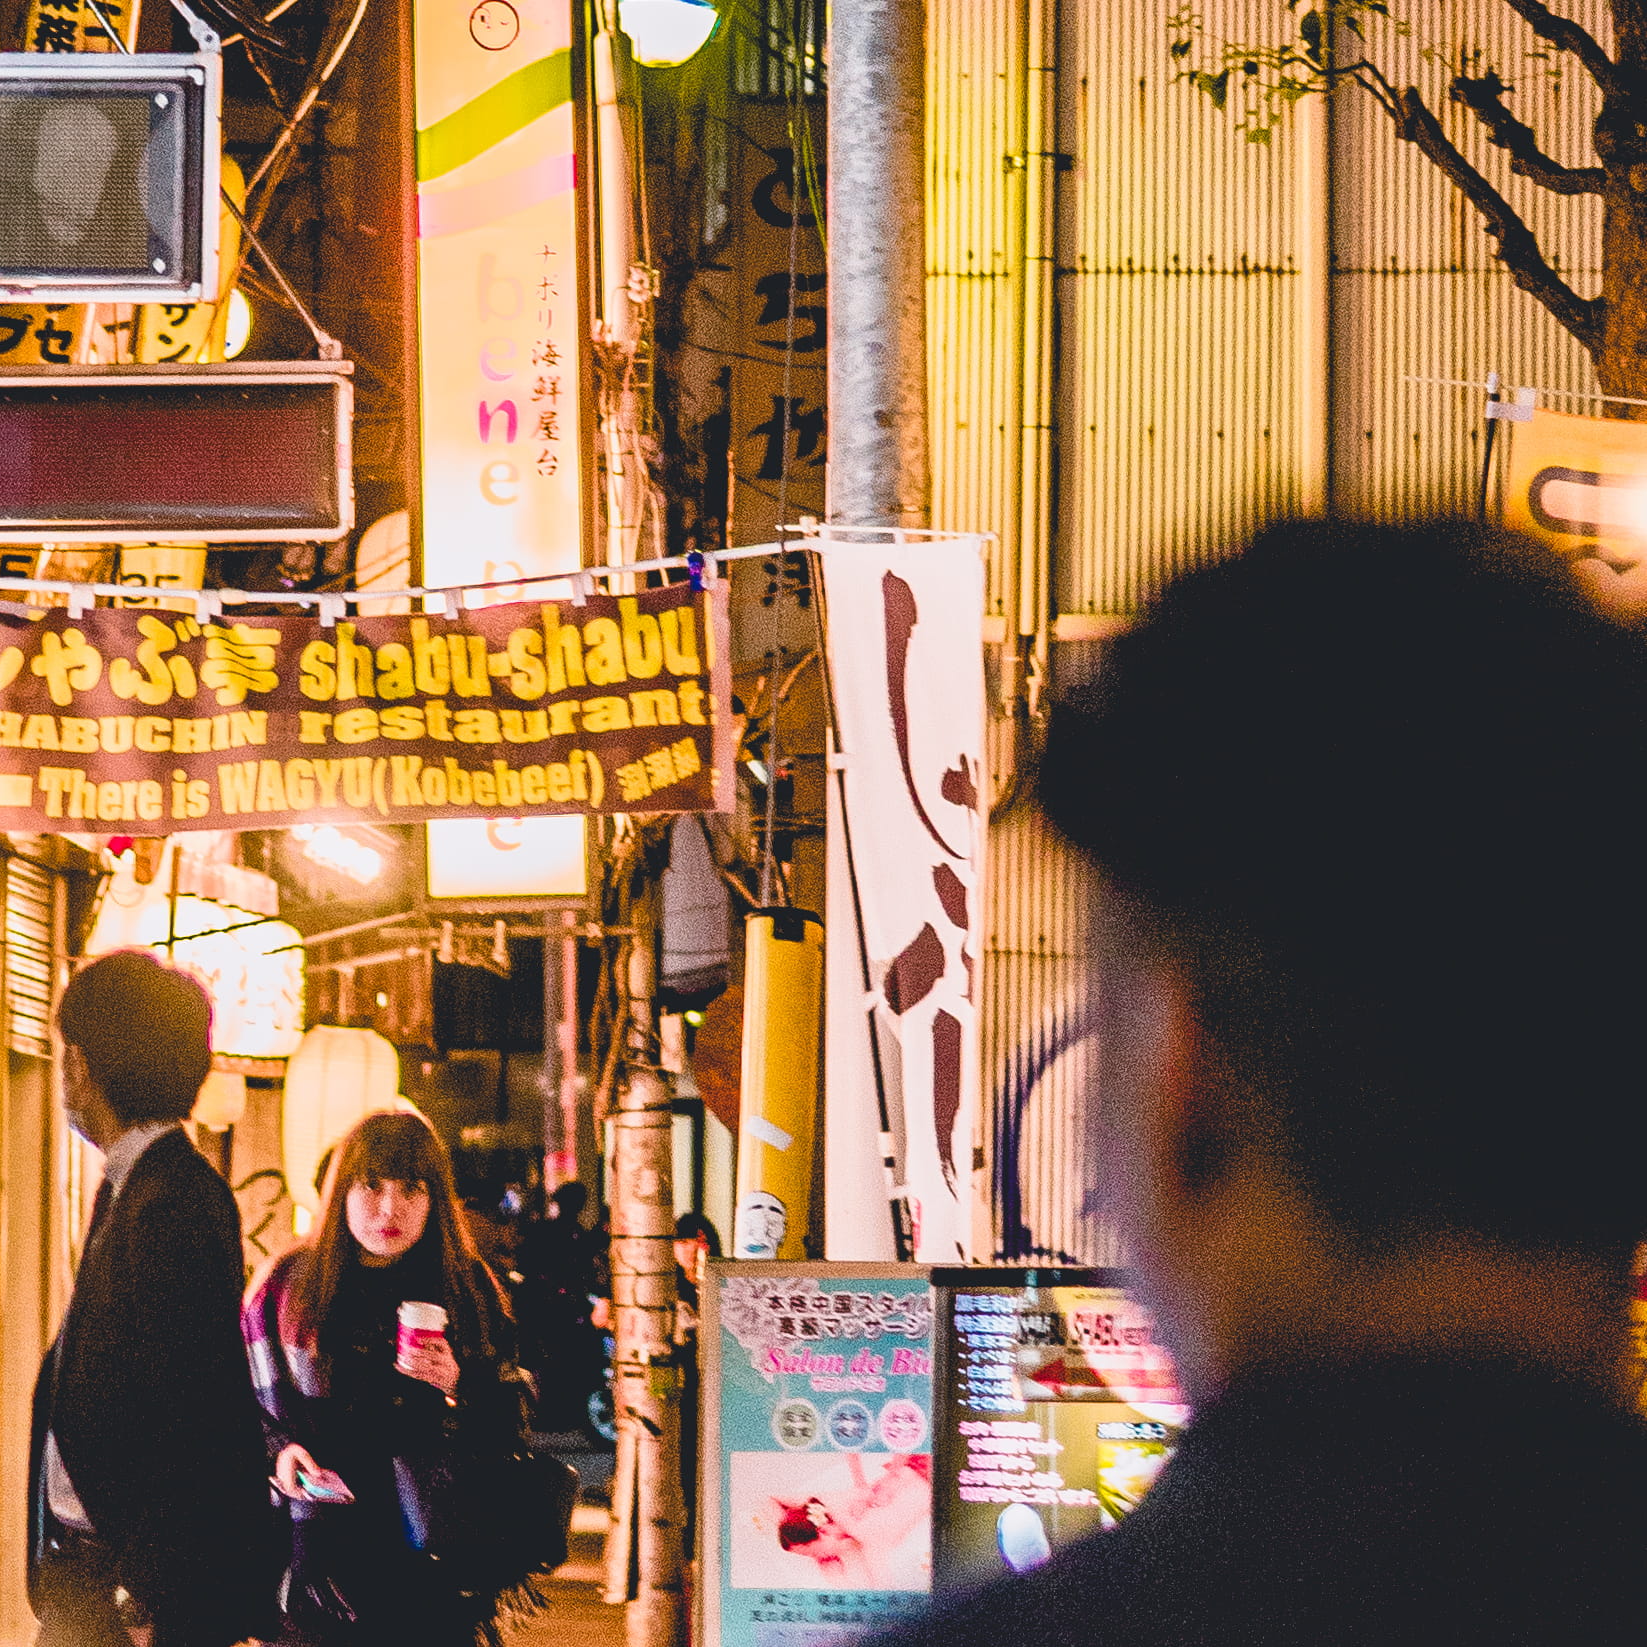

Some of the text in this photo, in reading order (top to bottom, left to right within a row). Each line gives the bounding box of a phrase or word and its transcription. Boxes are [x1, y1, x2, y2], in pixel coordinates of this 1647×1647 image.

[298, 680, 707, 745] restaurant
[39, 765, 164, 822] There
[170, 768, 211, 820] is
